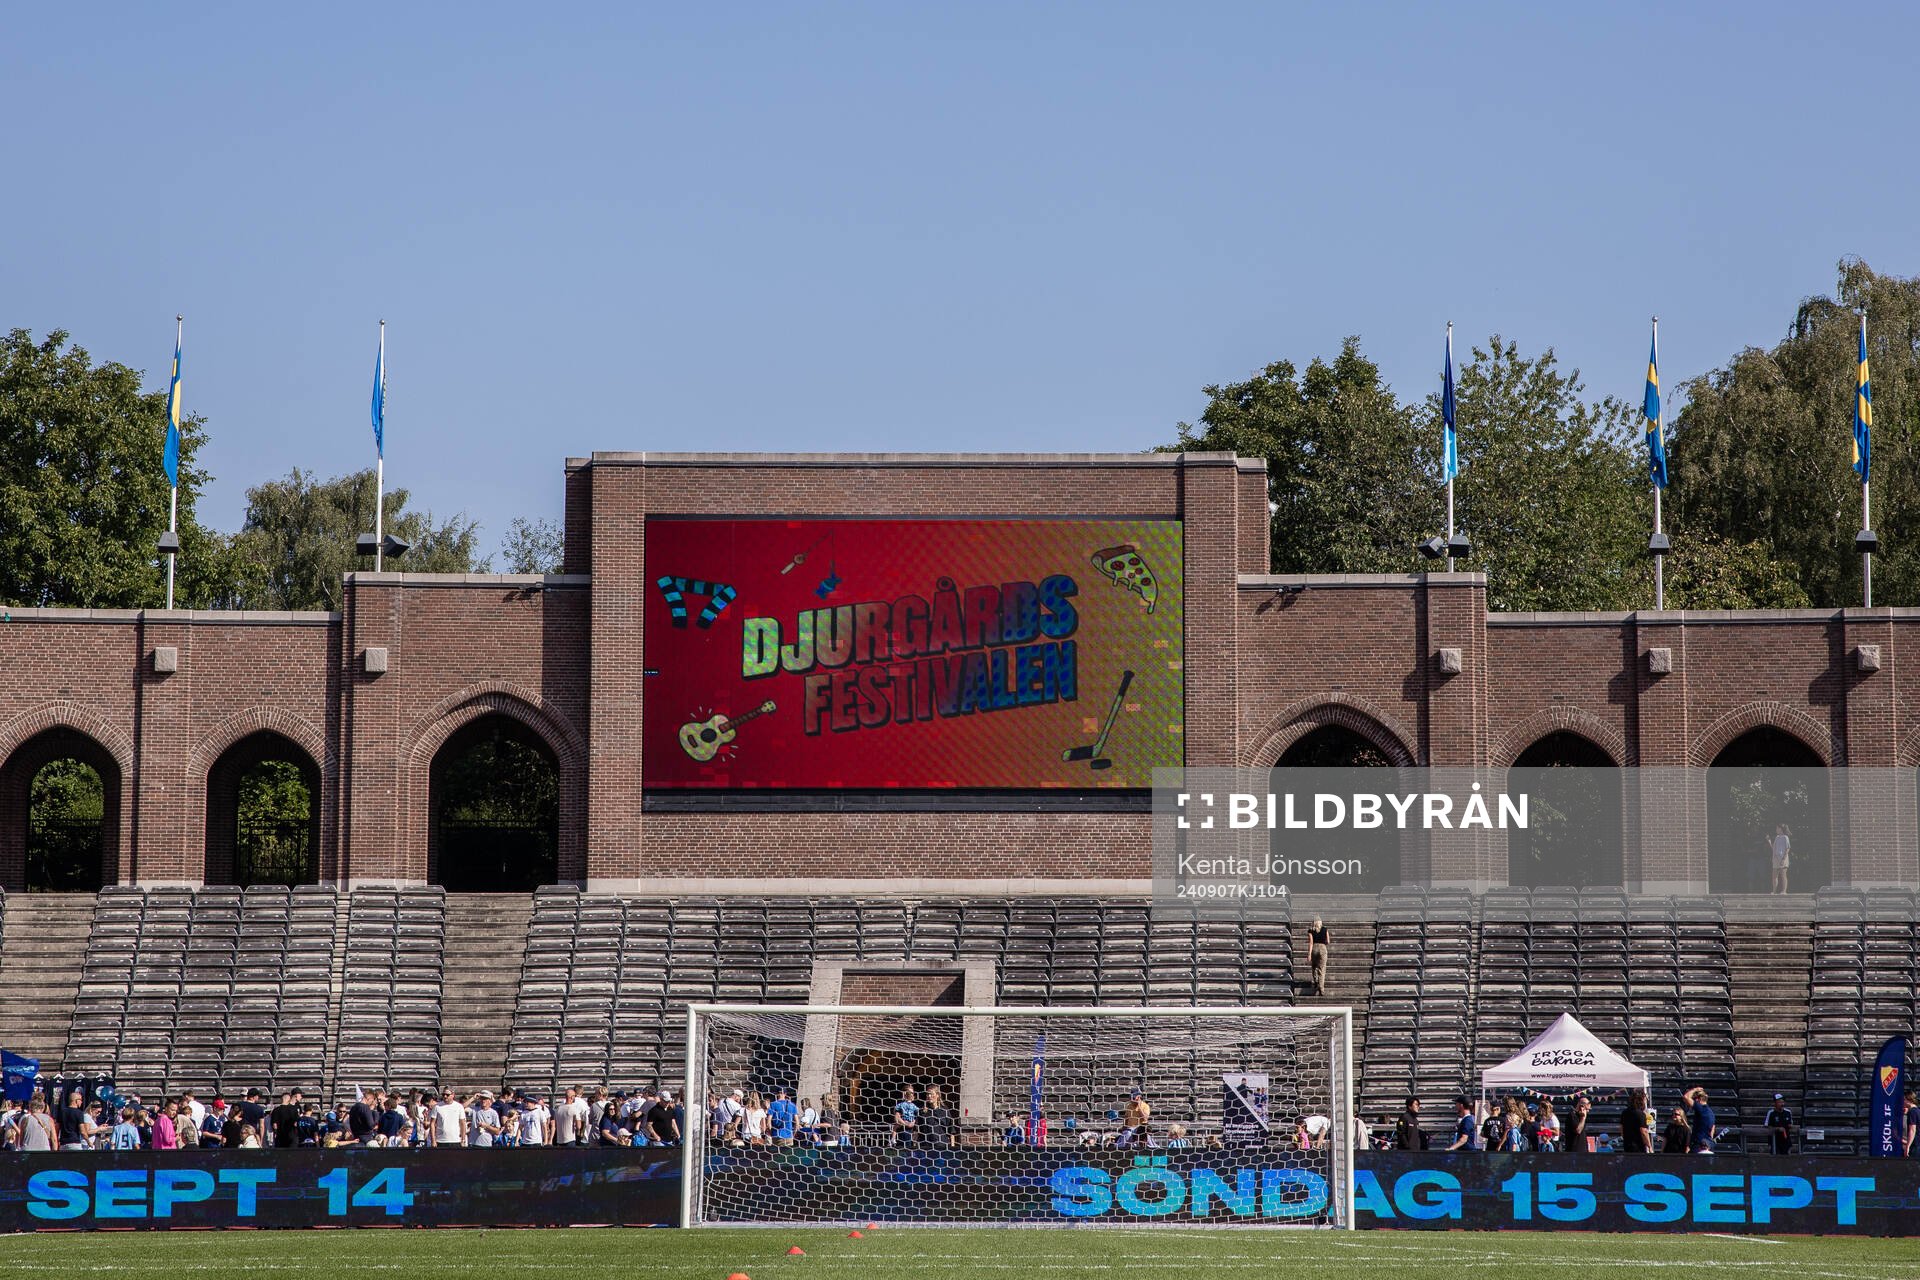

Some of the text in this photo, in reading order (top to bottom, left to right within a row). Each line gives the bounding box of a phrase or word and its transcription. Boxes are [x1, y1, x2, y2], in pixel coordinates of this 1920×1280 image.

[742, 574, 1078, 679] DJURGÅRDS
[804, 640, 1078, 735] FESTIVALEN
[1532, 1049, 1595, 1058] TRYGGA
[120, 1133, 130, 1148] 5
[1882, 1104, 1893, 1152] SKOL IF
[26, 1166, 414, 1219] SEPT 14
[1050, 1155, 1876, 1226] SÖNDAG 15 SEPT
